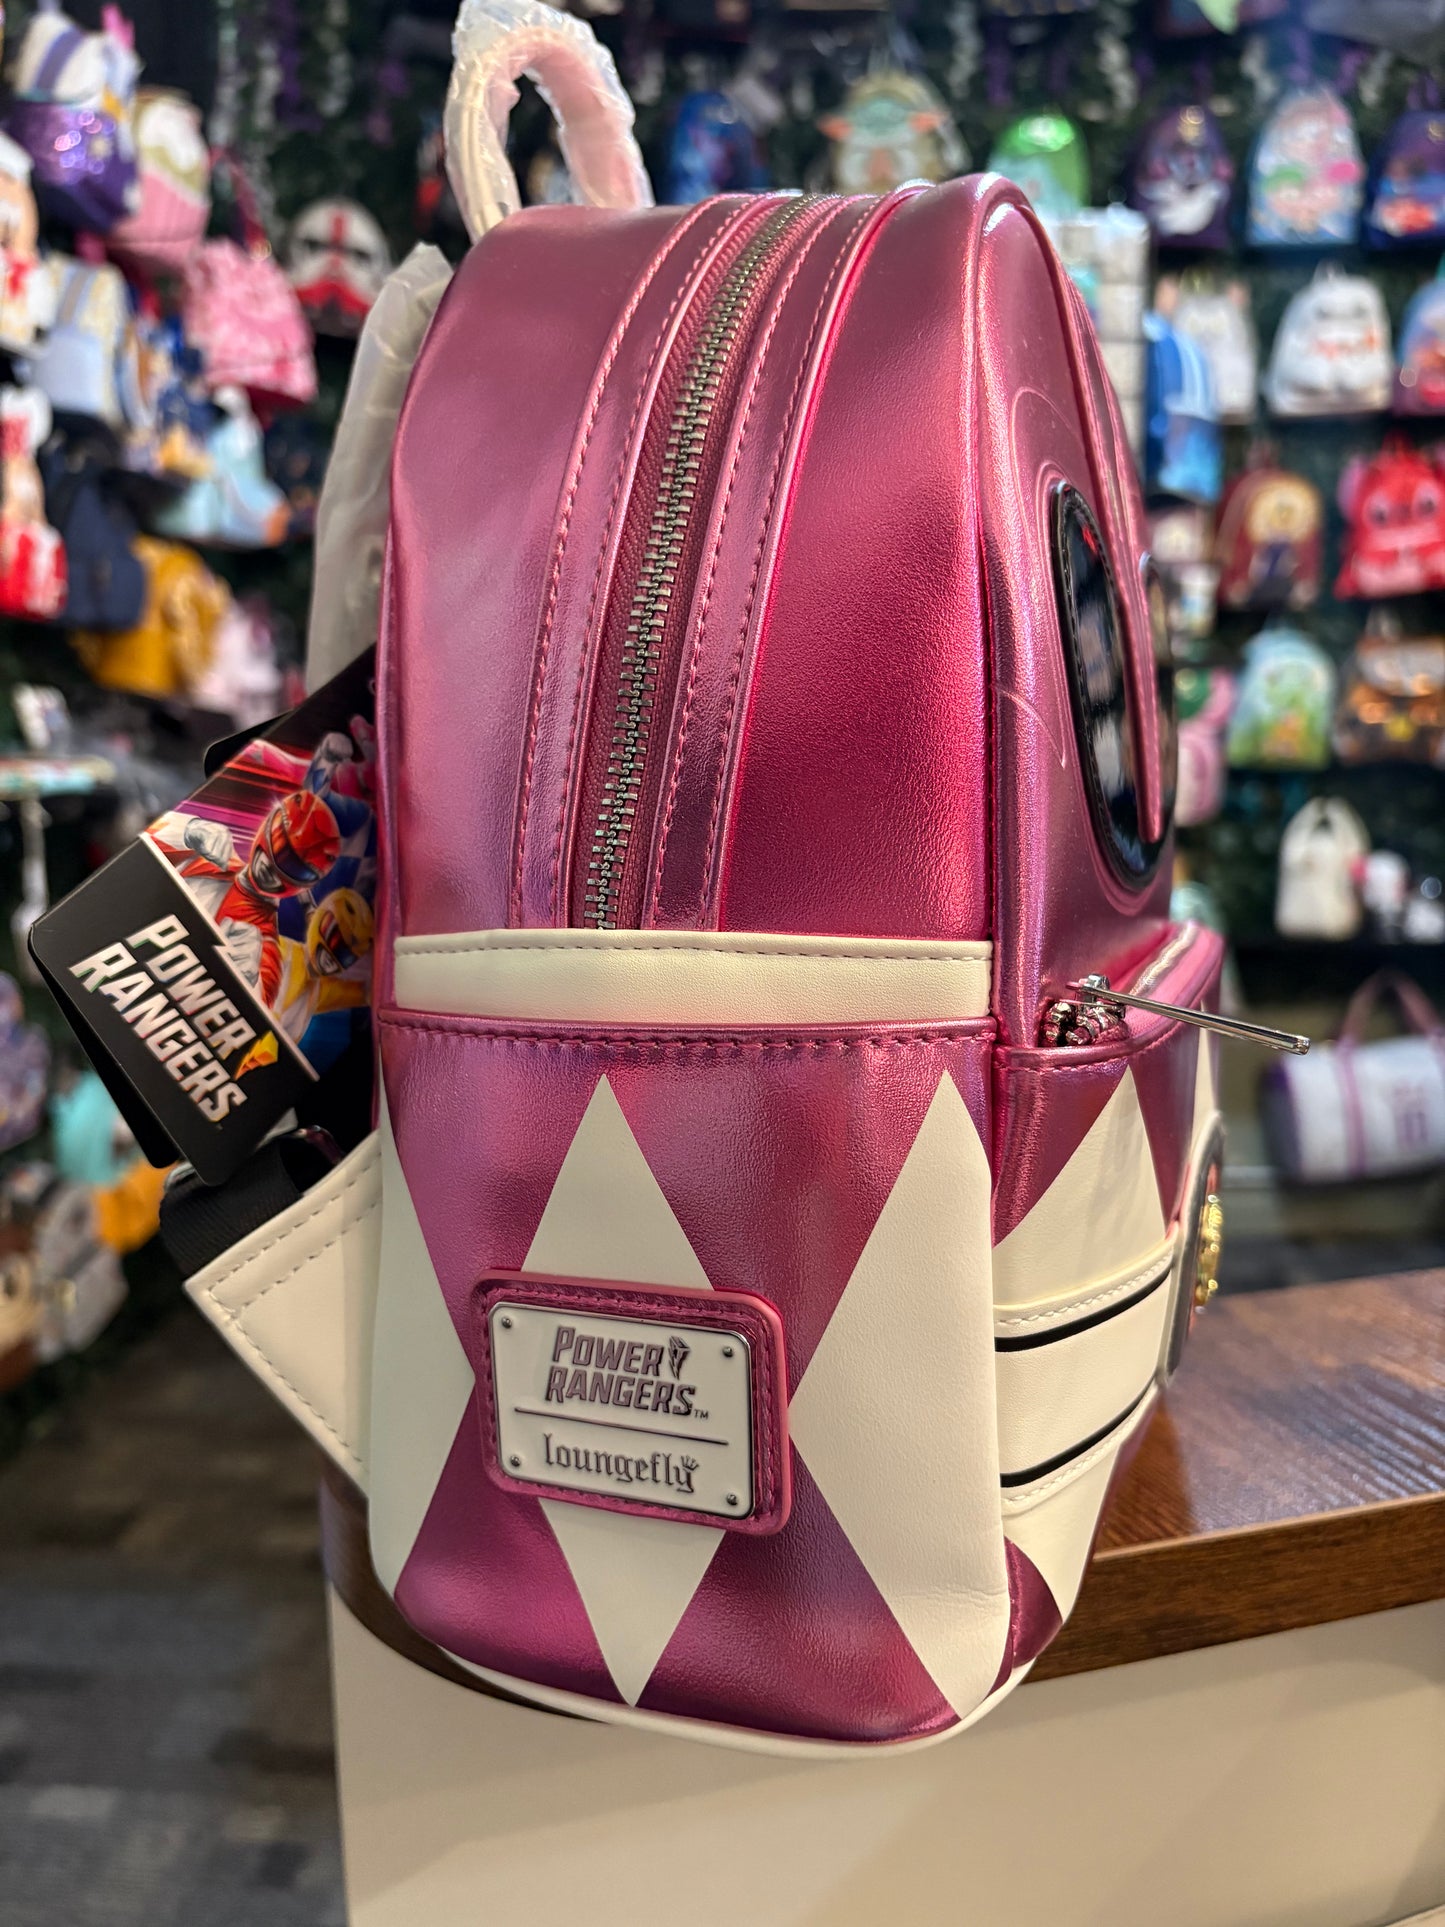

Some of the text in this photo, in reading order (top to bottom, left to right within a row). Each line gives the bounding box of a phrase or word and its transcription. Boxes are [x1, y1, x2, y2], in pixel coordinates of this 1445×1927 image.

[125, 914, 257, 1060] POWER
[68, 942, 248, 1122] RANGERS
[553, 1326, 664, 1376] POWER
[545, 1366, 696, 1416] RANGERS
[543, 1433, 699, 1493] loungefly
